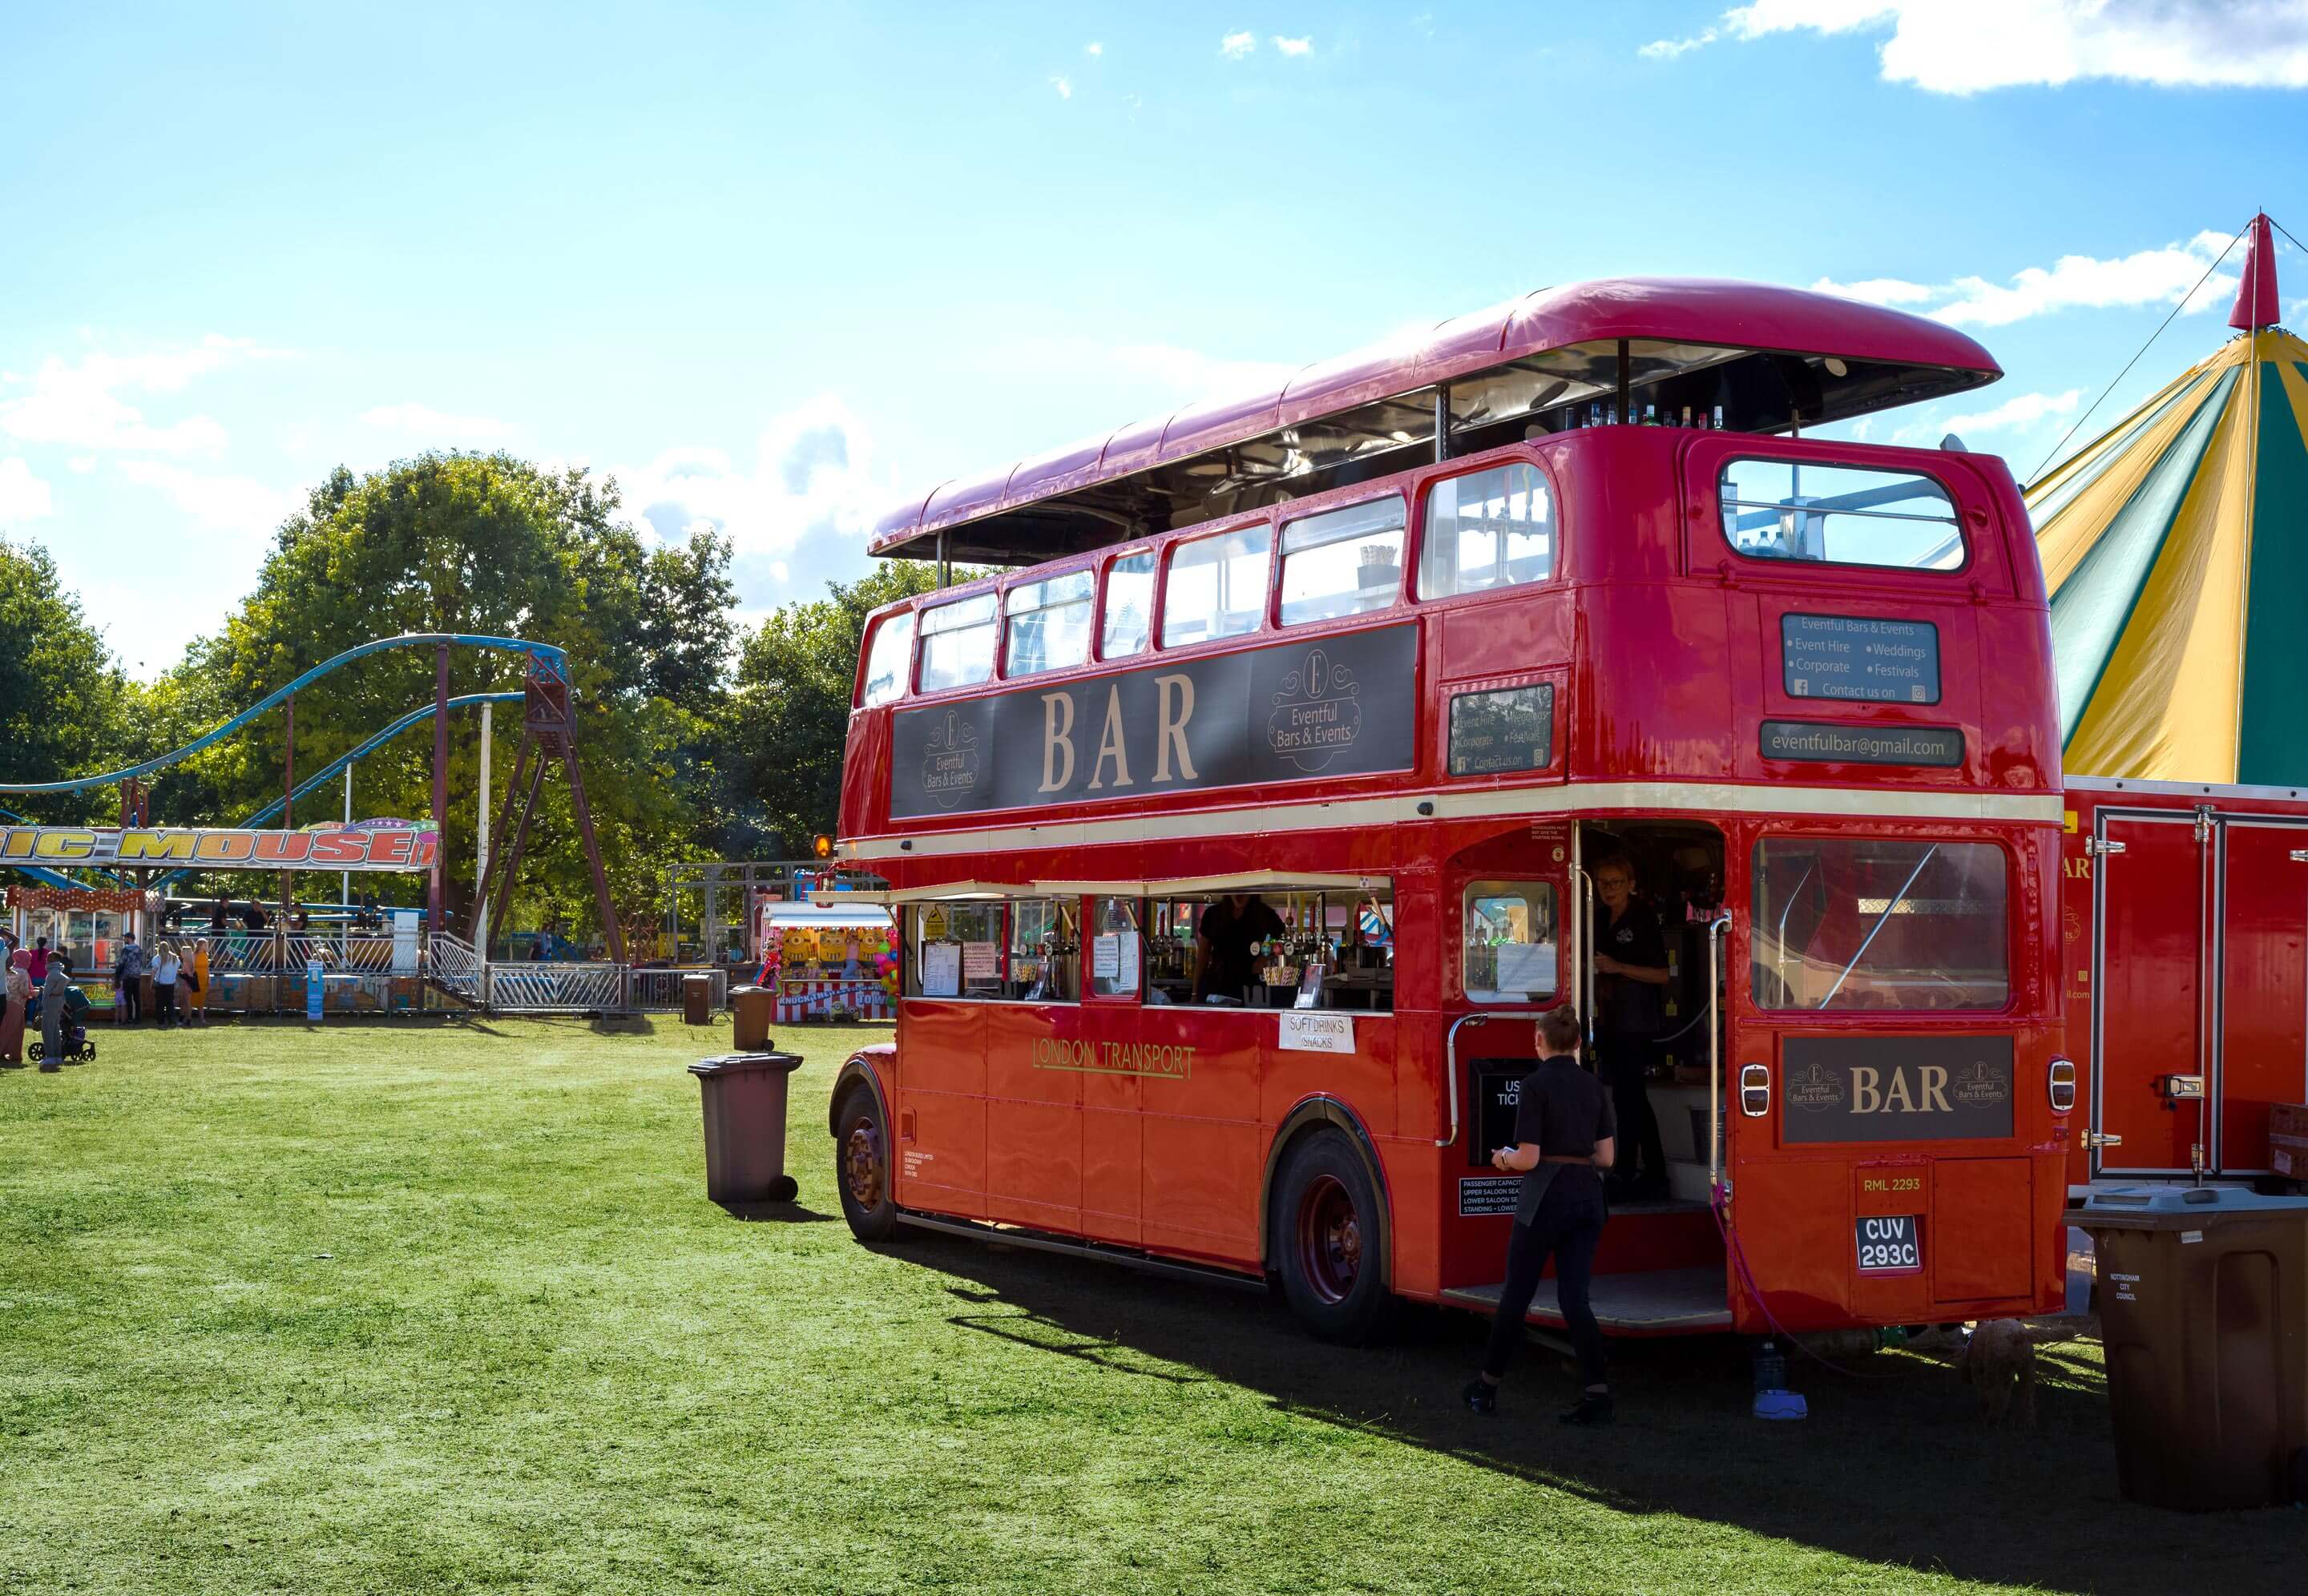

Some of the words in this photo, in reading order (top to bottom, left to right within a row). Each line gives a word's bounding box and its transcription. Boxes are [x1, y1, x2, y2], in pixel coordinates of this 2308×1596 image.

[1802, 617, 1844, 631] Eventful
[1846, 621, 1868, 633] Bars
[1870, 623, 1878, 634] &
[1880, 623, 1915, 635] Events
[1795, 638, 1826, 651] Event
[1828, 640, 1850, 653] Hire
[1873, 643, 1927, 661] Weddings
[1796, 657, 1850, 674] Corporate
[1874, 663, 1919, 678] Festivals
[1822, 683, 1865, 697] Contact
[1867, 687, 1878, 697] us
[1882, 688, 1895, 699] on
[1292, 702, 1338, 726] Eventful
[1038, 673, 1199, 793] BAR
[1277, 730, 1300, 748] Bars
[1302, 727, 1312, 744] &
[1315, 724, 1351, 744] Events
[1772, 733, 1944, 757] eventfulbar@gmail.com
[936, 753, 965, 771] Eventful
[927, 773, 942, 788] Bars
[942, 772, 949, 786] &
[950, 771, 973, 785] Events
[0, 830, 96, 858] IC
[2064, 856, 2092, 879] AR
[1290, 1017, 1312, 1031] SOFT
[1313, 1018, 1345, 1034] DRINKS
[1032, 1038, 1095, 1068] LONDON
[1102, 1041, 1196, 1079] TRANSPORT
[1505, 1081, 1520, 1092] US
[1802, 1085, 1830, 1094] Eventful
[1848, 1066, 1954, 1114] BAR
[1959, 1090, 1973, 1098] Bars
[1974, 1090, 1980, 1098] &
[1967, 1082, 1994, 1090] Eventful
[1864, 1179, 1890, 1191] RML
[1892, 1179, 1920, 1191] 2293
[1866, 1218, 1904, 1240] CUV
[1862, 1243, 1915, 1266] 293C
[2110, 1273, 2141, 1282] NOTTINGHAM
[2120, 1283, 2129, 1291] CITY
[2116, 1292, 2137, 1300] COUNCIL
